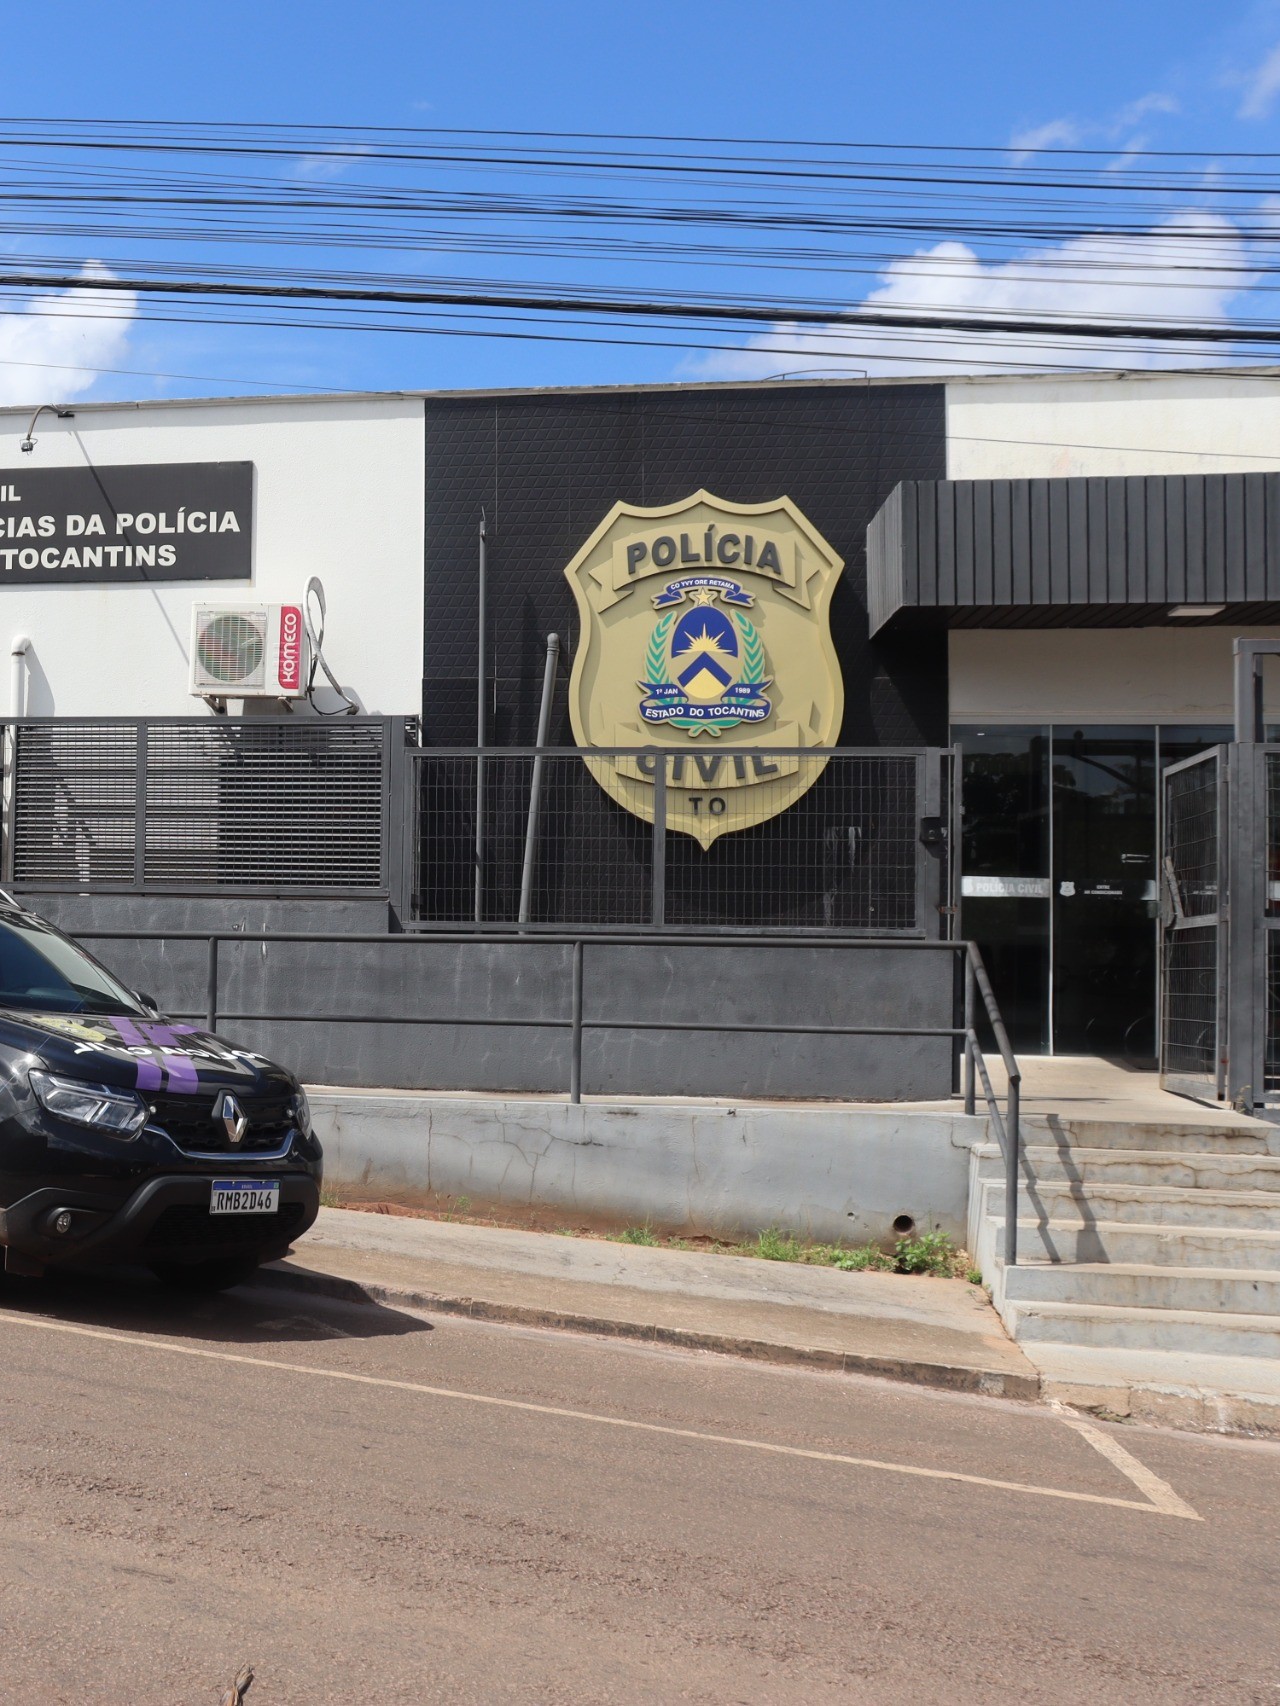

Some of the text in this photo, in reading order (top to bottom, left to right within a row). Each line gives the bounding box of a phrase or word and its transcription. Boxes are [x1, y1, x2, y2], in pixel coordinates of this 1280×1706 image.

[66, 513, 107, 536] DA
[115, 507, 241, 535] POLÍCIA
[0, 545, 177, 570] TOCANTINS
[625, 524, 782, 576] POLÍCIA
[681, 580, 694, 588] YVY
[708, 579, 735, 590] RETAMA
[645, 706, 766, 718] ESTADO DO TOCANTINS
[688, 797, 726, 816] TO
[1017, 883, 1044, 894] CIVIL
[216, 1191, 272, 1211] RMB2D46
